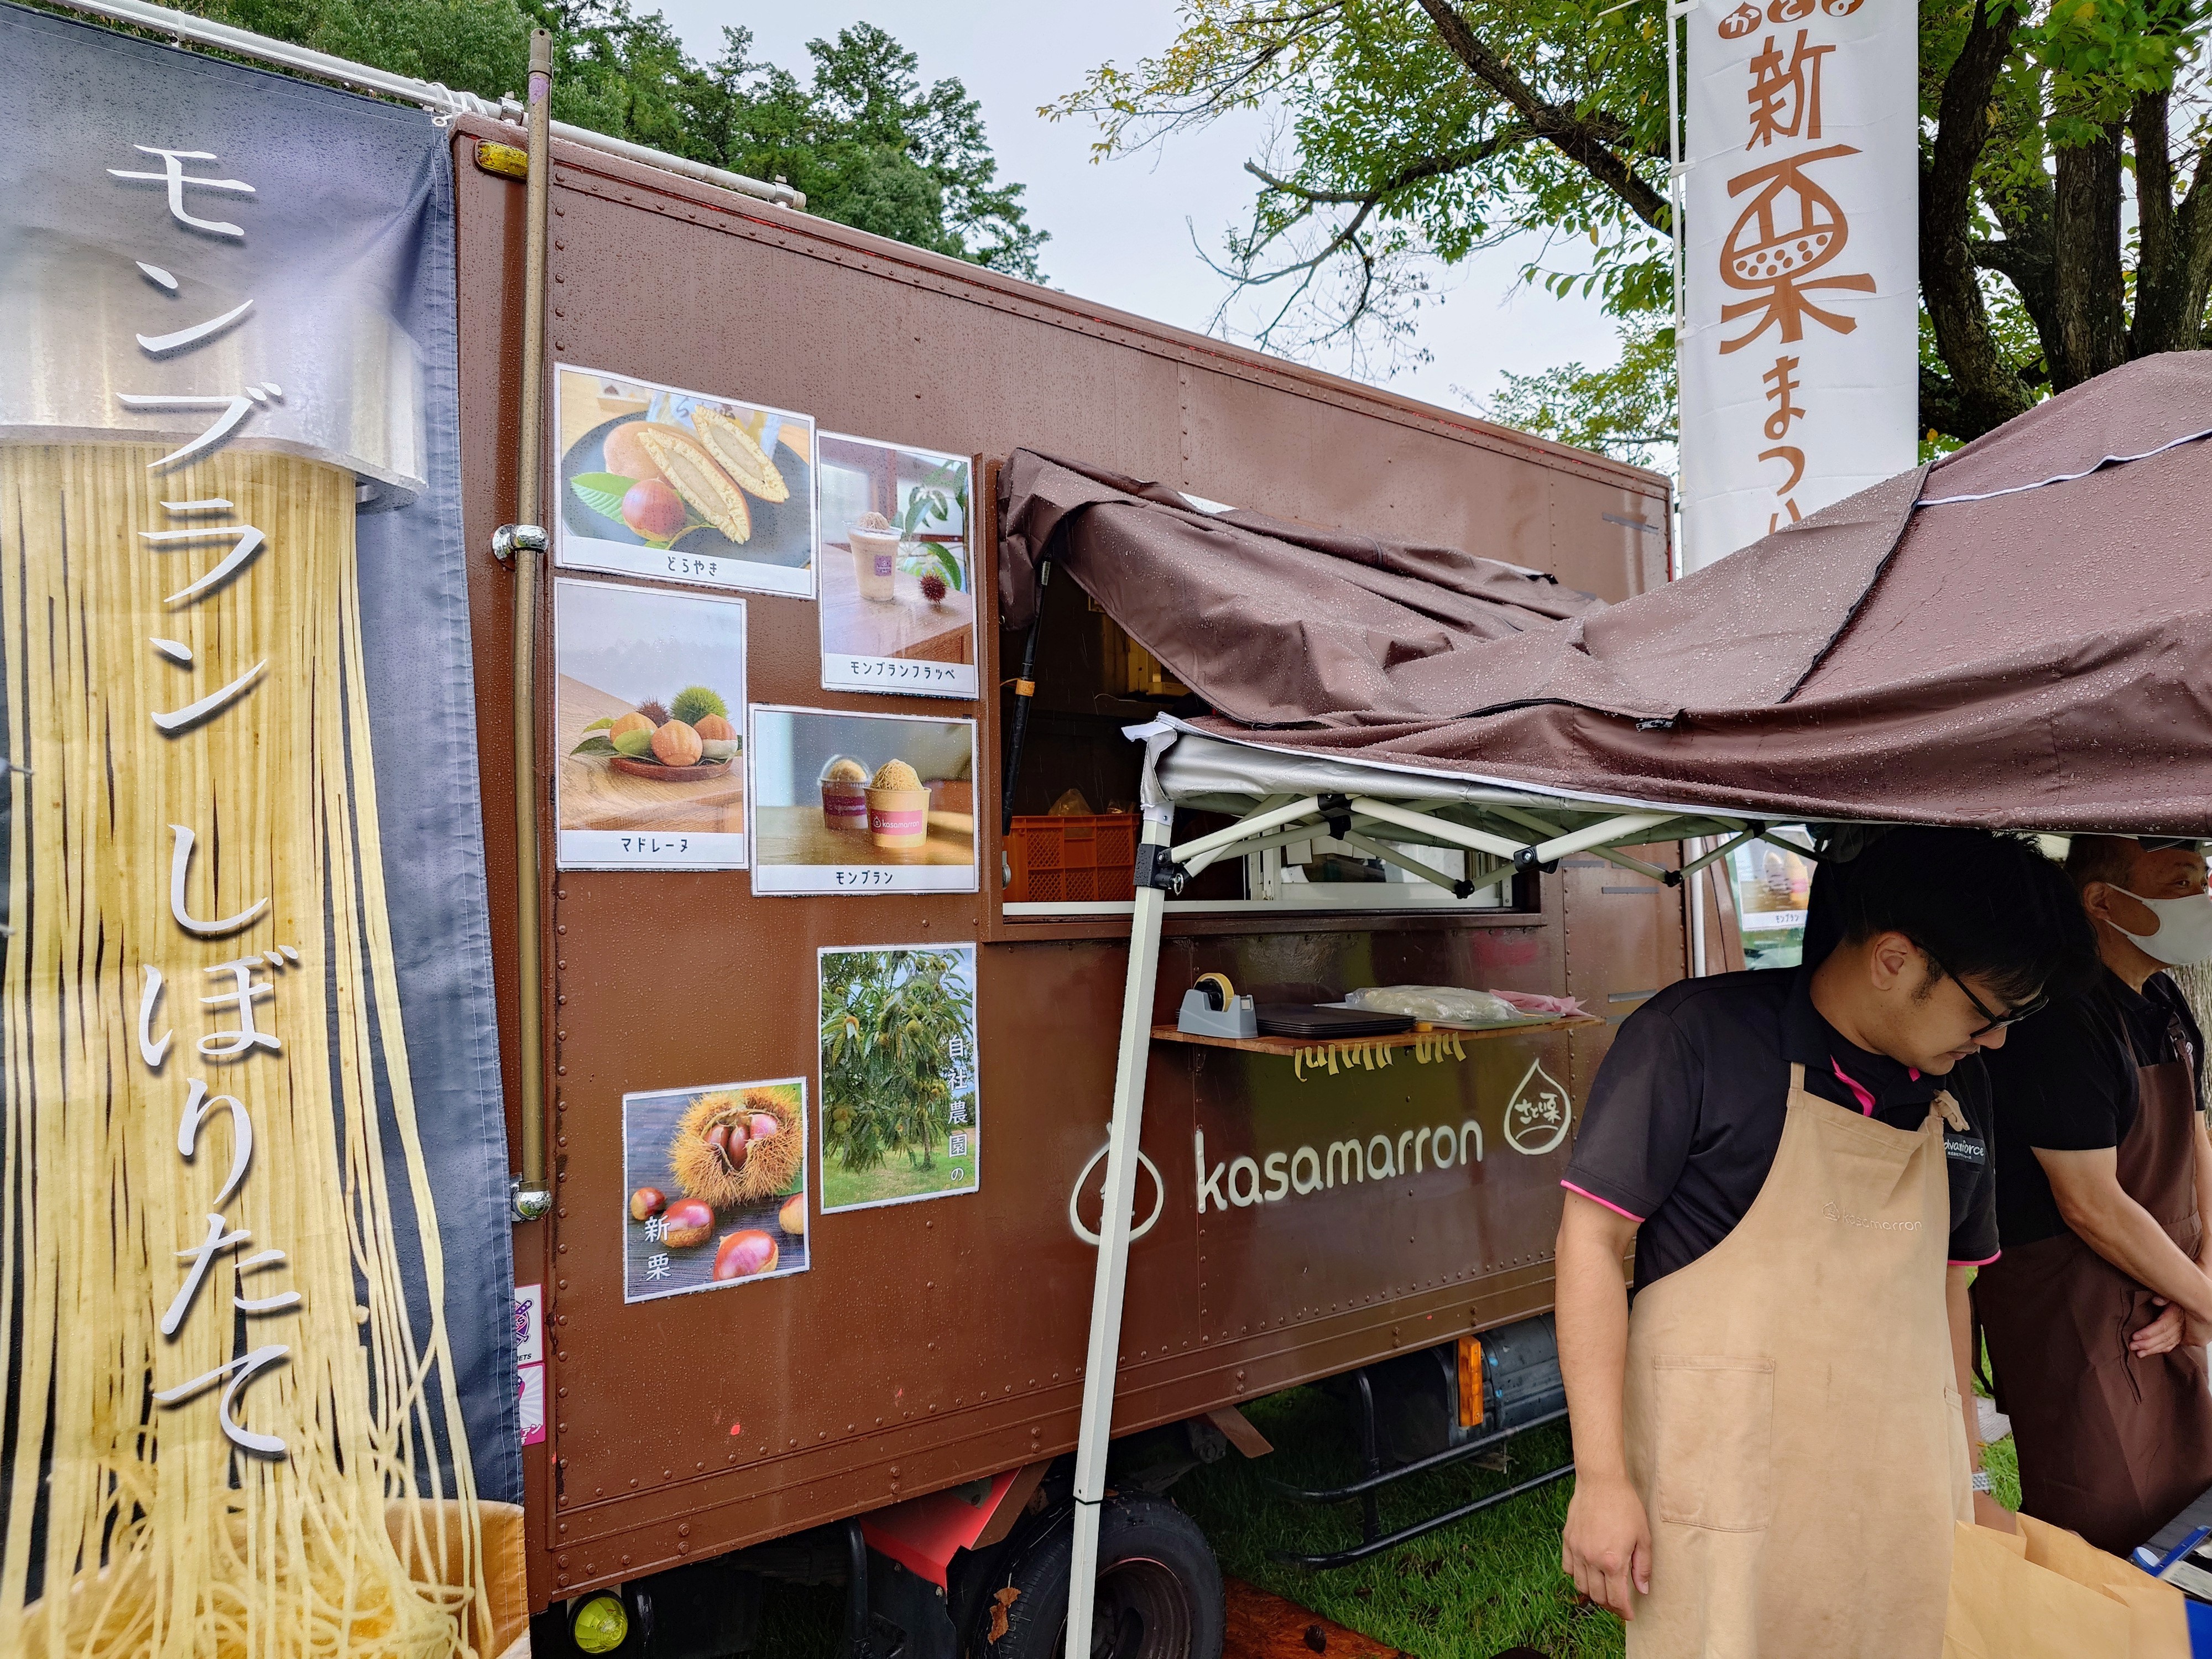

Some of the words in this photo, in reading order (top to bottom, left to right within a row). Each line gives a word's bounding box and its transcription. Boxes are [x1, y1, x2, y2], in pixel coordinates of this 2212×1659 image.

[106, 143, 283, 729] モンブラン
[667, 556, 718, 576] どらやき
[850, 661, 956, 680] モンブランフラッペ
[620, 837, 688, 853] マドレーヌ
[836, 869, 893, 885] モンブラン
[947, 1034, 968, 1182] 自社農園の
[138, 823, 302, 1453] しぼりたて
[1194, 1119, 1484, 1214] kasamarron
[1841, 1206, 1923, 1232] kasamarron
[644, 1215, 672, 1282] 新栗
